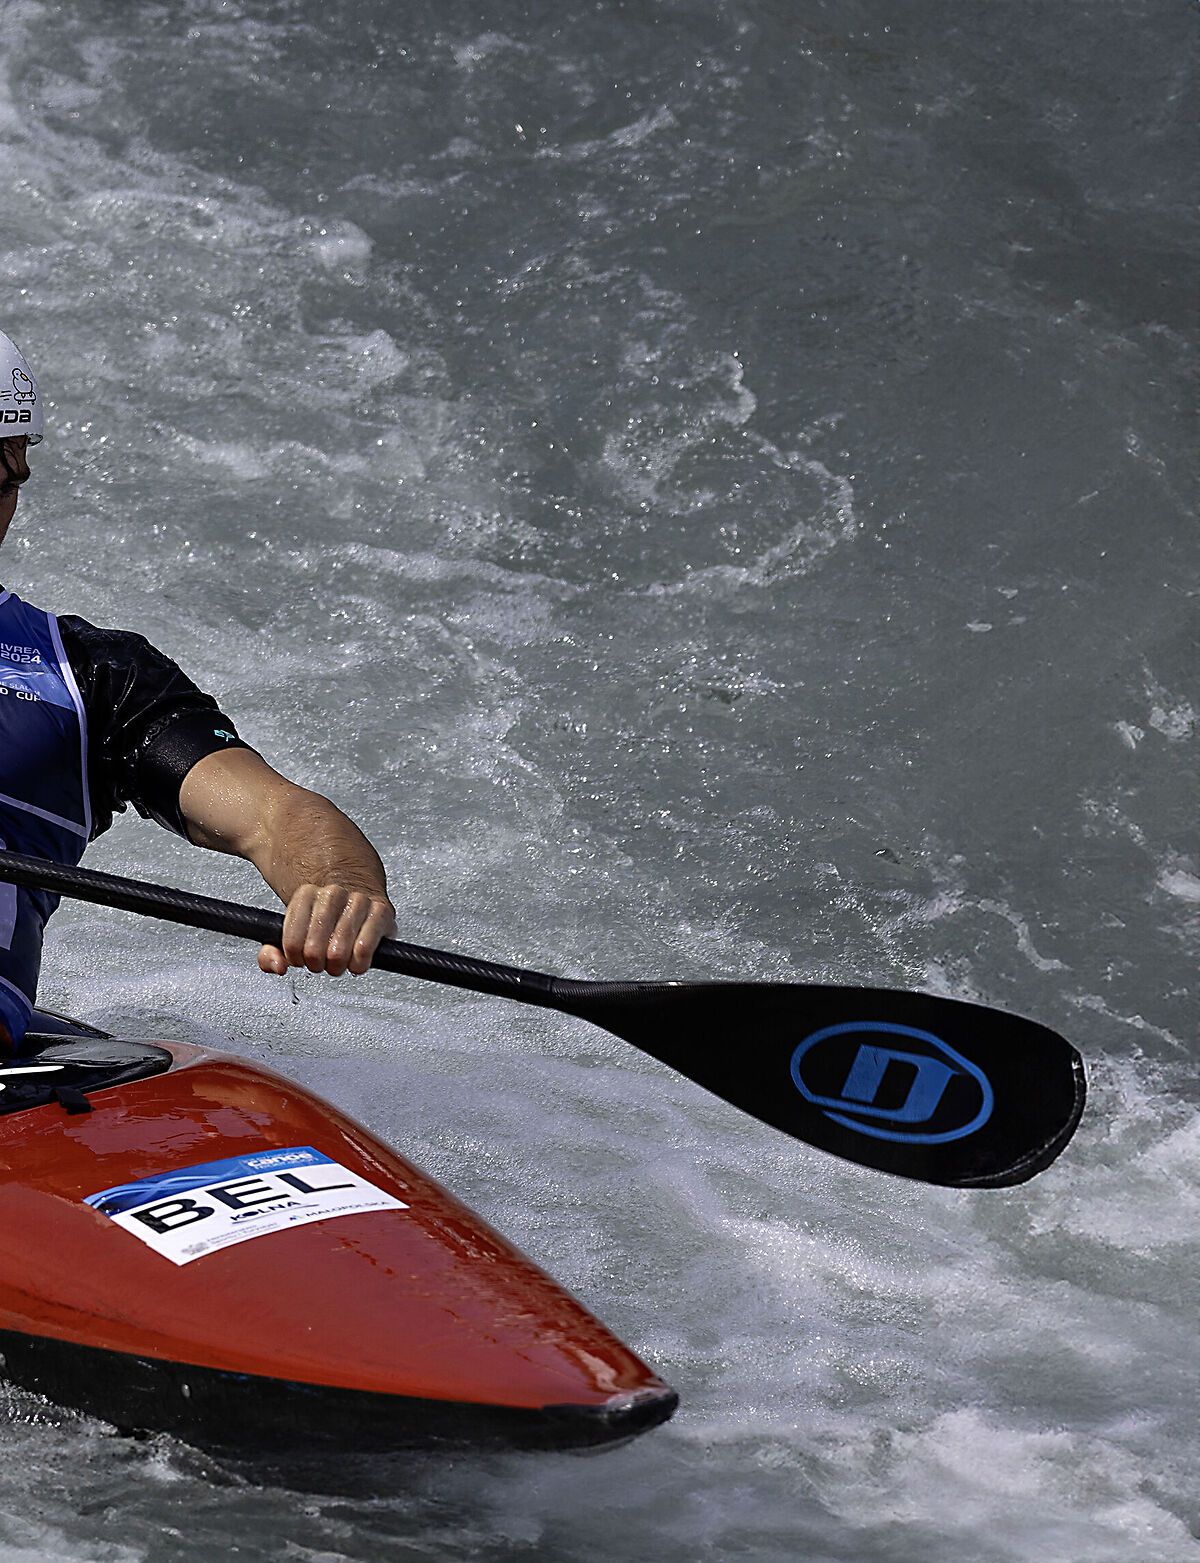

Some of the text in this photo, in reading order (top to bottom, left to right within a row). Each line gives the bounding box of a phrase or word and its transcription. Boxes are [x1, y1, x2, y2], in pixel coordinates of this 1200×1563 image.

[0, 642, 42, 655] IVREA
[0, 649, 42, 664] 2024
[130, 1172, 357, 1235] BEL
